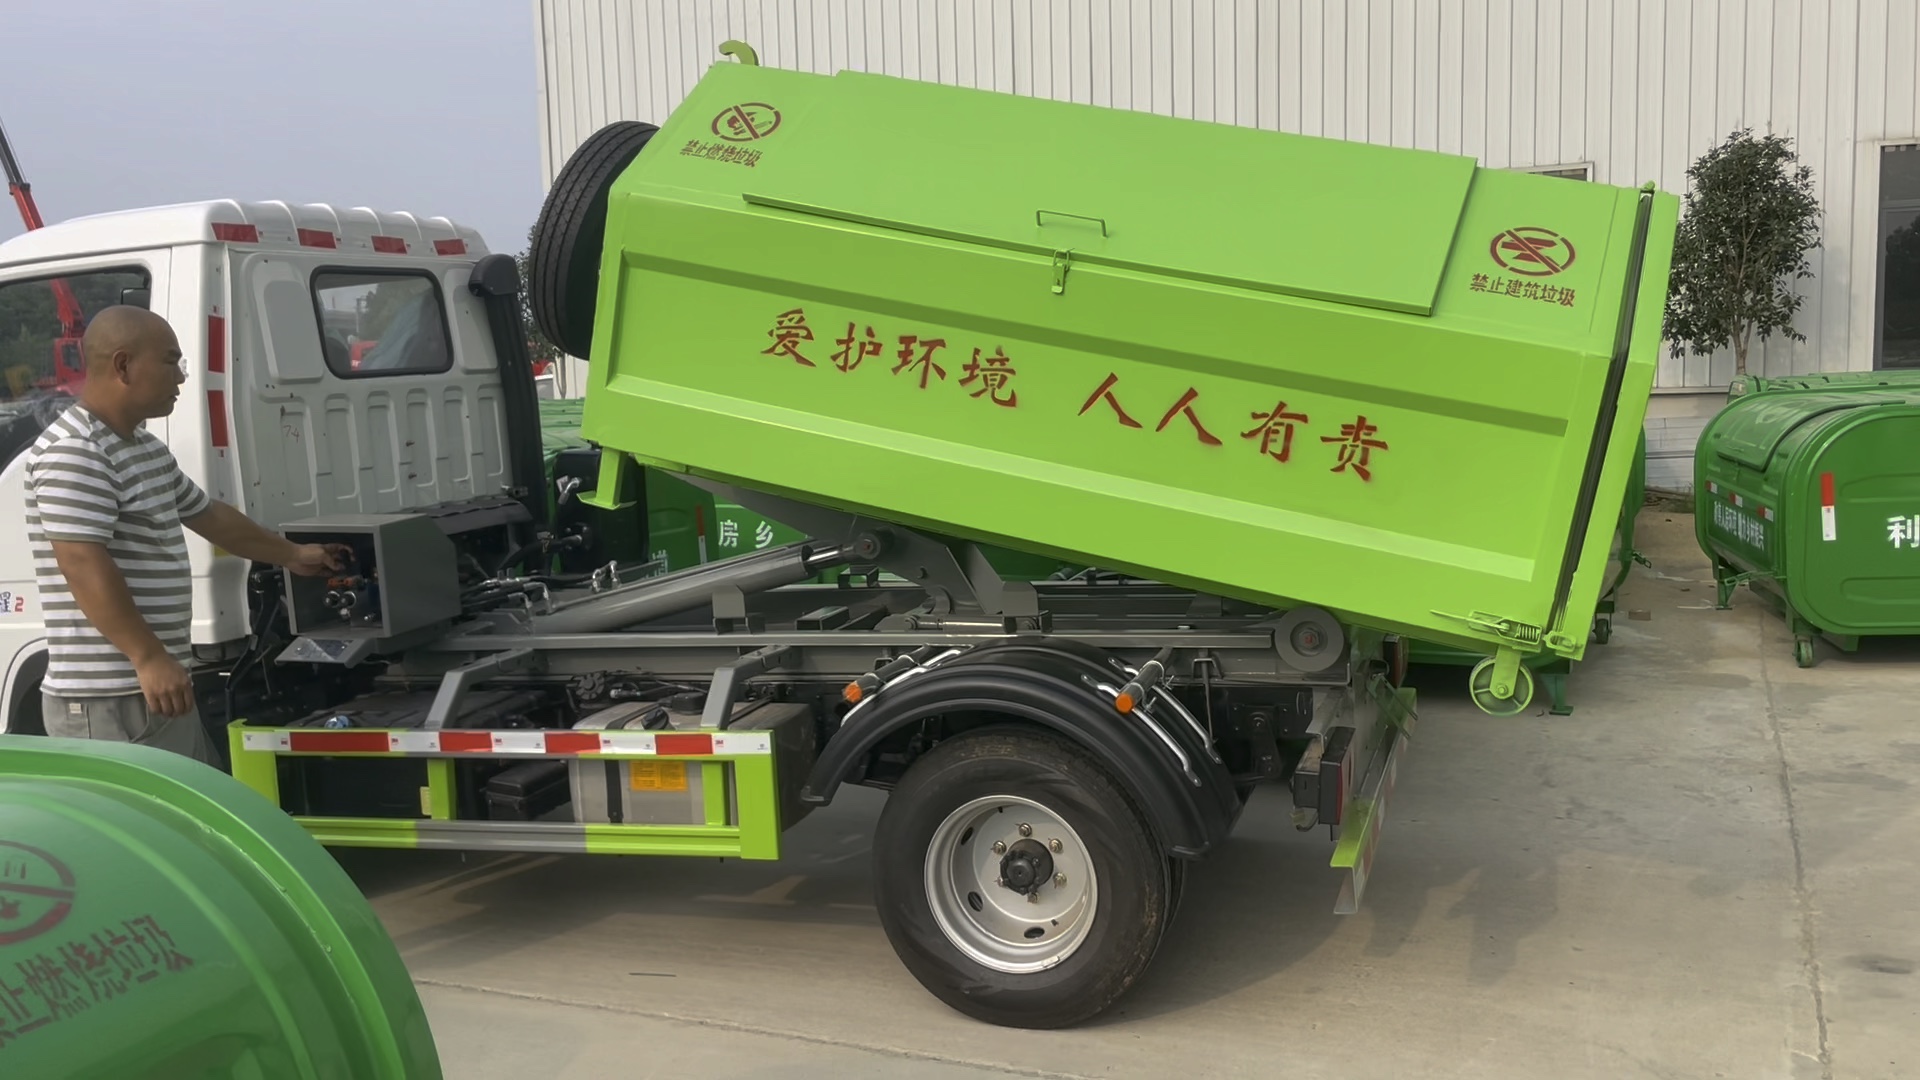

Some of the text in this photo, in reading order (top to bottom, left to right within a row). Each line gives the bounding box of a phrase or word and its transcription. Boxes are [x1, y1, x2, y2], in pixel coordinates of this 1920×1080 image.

[680, 139, 764, 168] 禁止燃烧垃圾
[1469, 272, 1576, 308] 禁止建筑垃圾
[760, 308, 1390, 482] 爱护环境 人人有责
